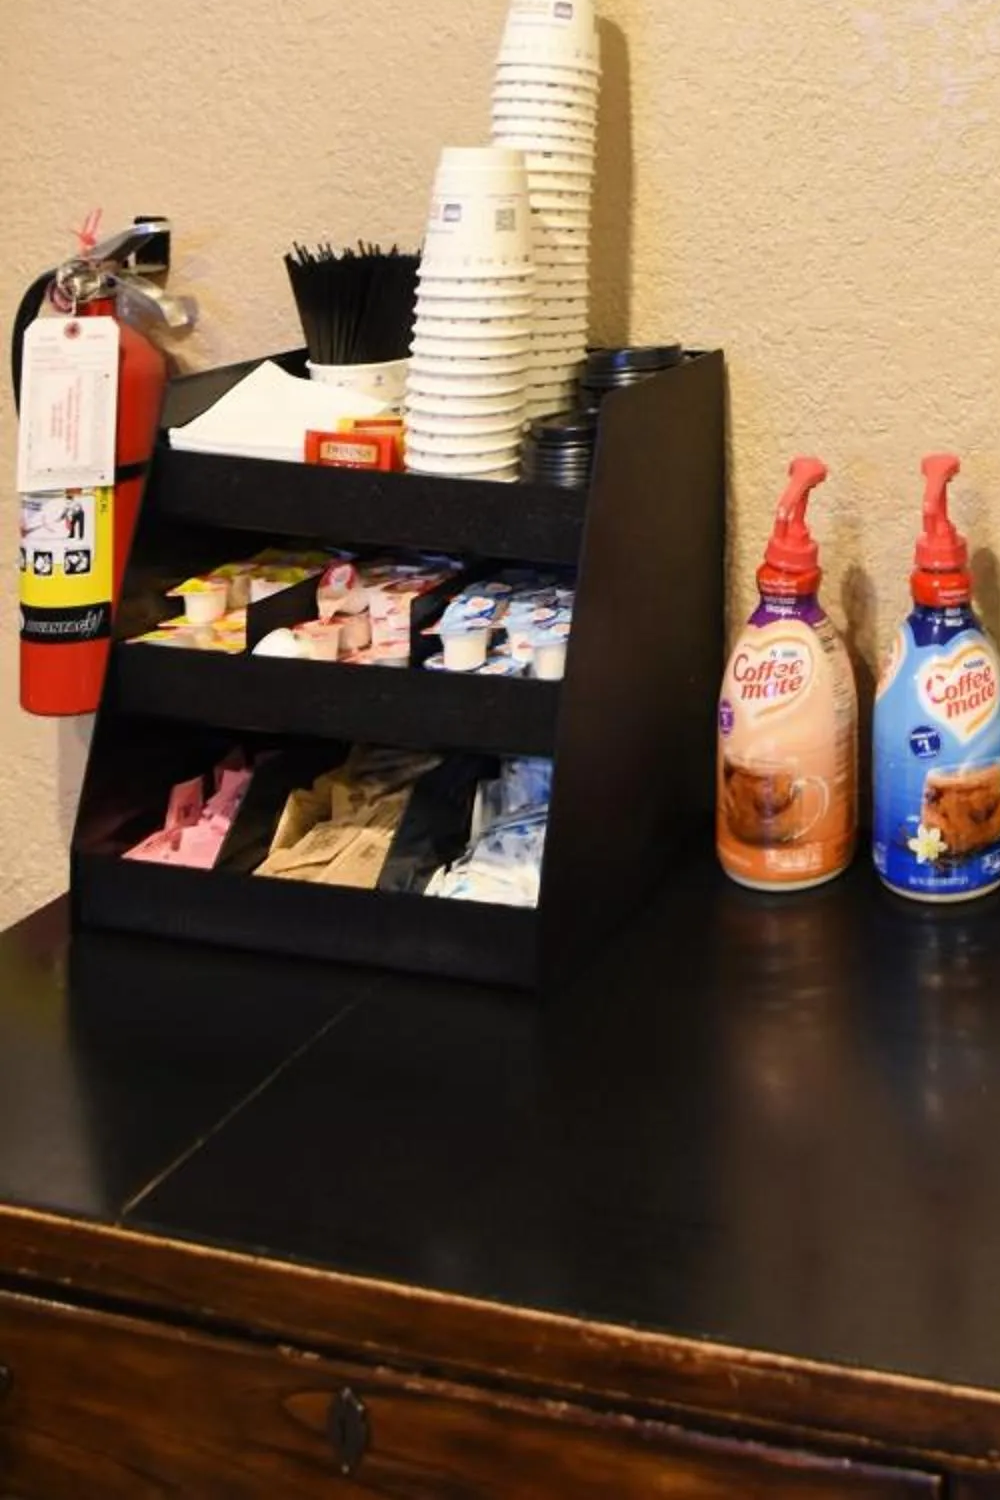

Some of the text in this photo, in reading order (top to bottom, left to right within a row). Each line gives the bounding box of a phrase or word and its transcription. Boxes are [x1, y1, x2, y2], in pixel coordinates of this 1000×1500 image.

[733, 653, 804, 682] Coffee
[741, 674, 804, 701] mate
[926, 666, 992, 704] Coffee
[945, 681, 995, 719] mate
